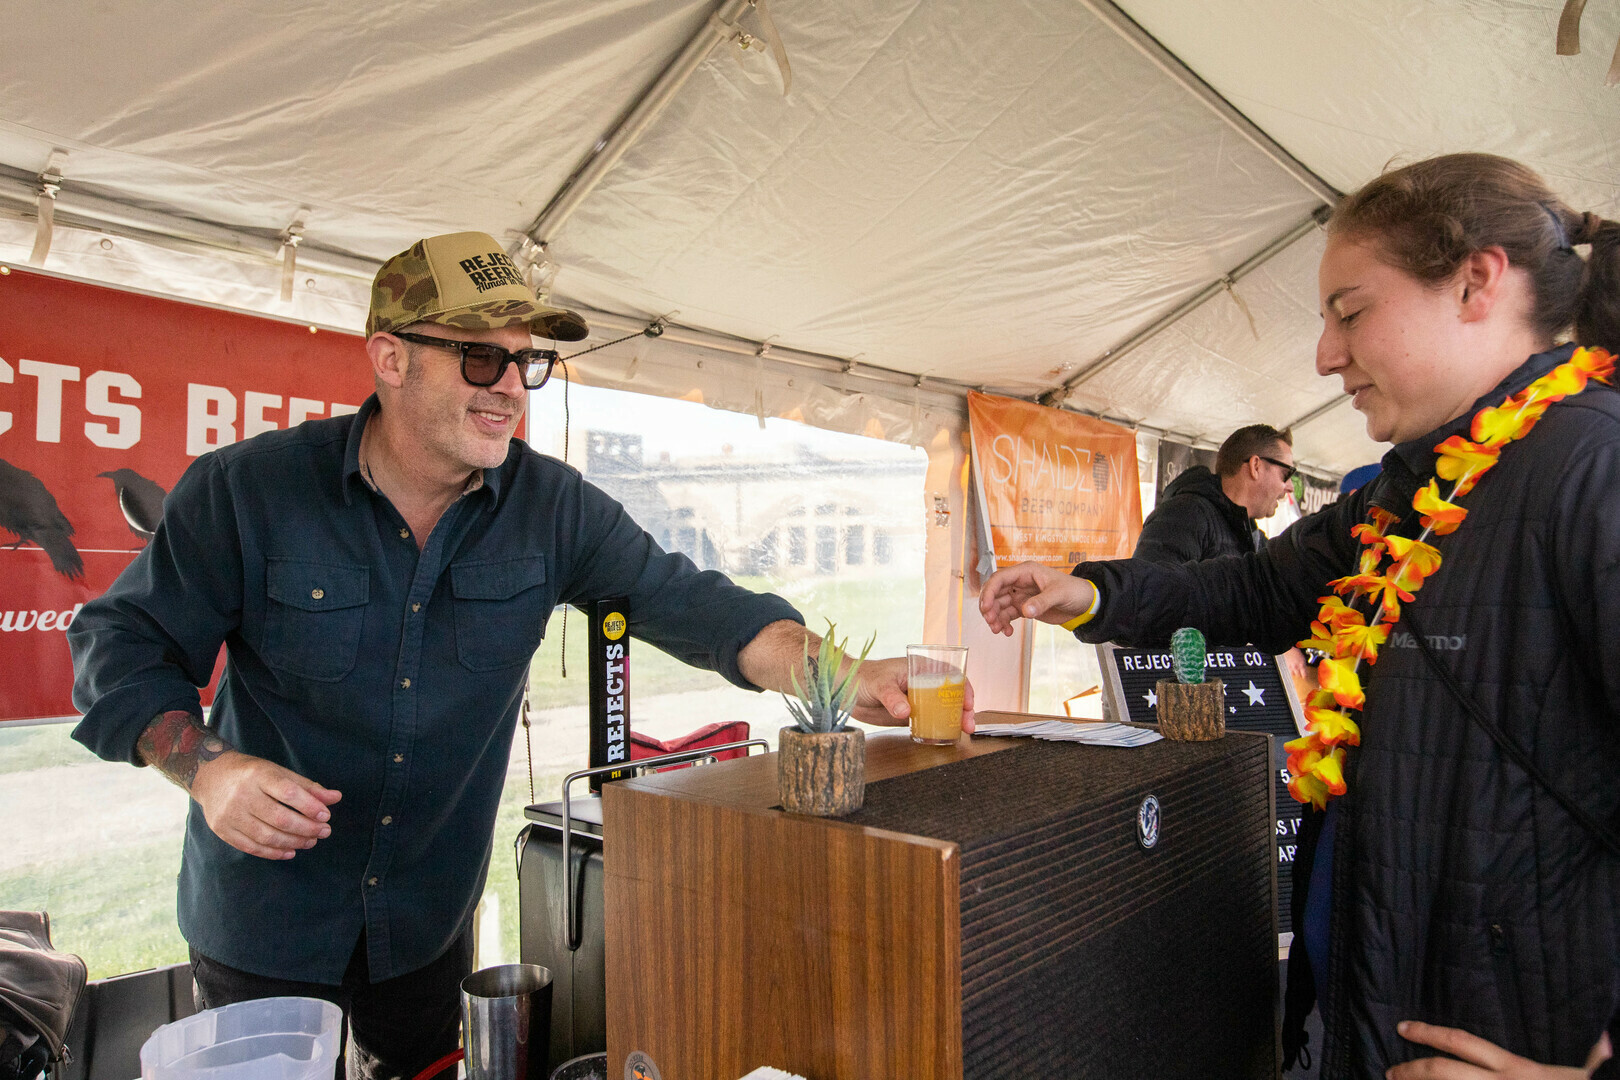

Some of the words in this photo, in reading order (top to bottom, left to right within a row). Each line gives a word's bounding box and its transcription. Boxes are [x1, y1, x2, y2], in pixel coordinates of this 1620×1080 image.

[469, 266, 514, 286] BEER
[0, 356, 142, 450] TS
[1021, 497, 1053, 515] BEER
[1058, 500, 1105, 517] COMPANY
[0, 603, 83, 632] wed
[1244, 652, 1267, 667] CO.
[606, 643, 624, 763] REJECTS
